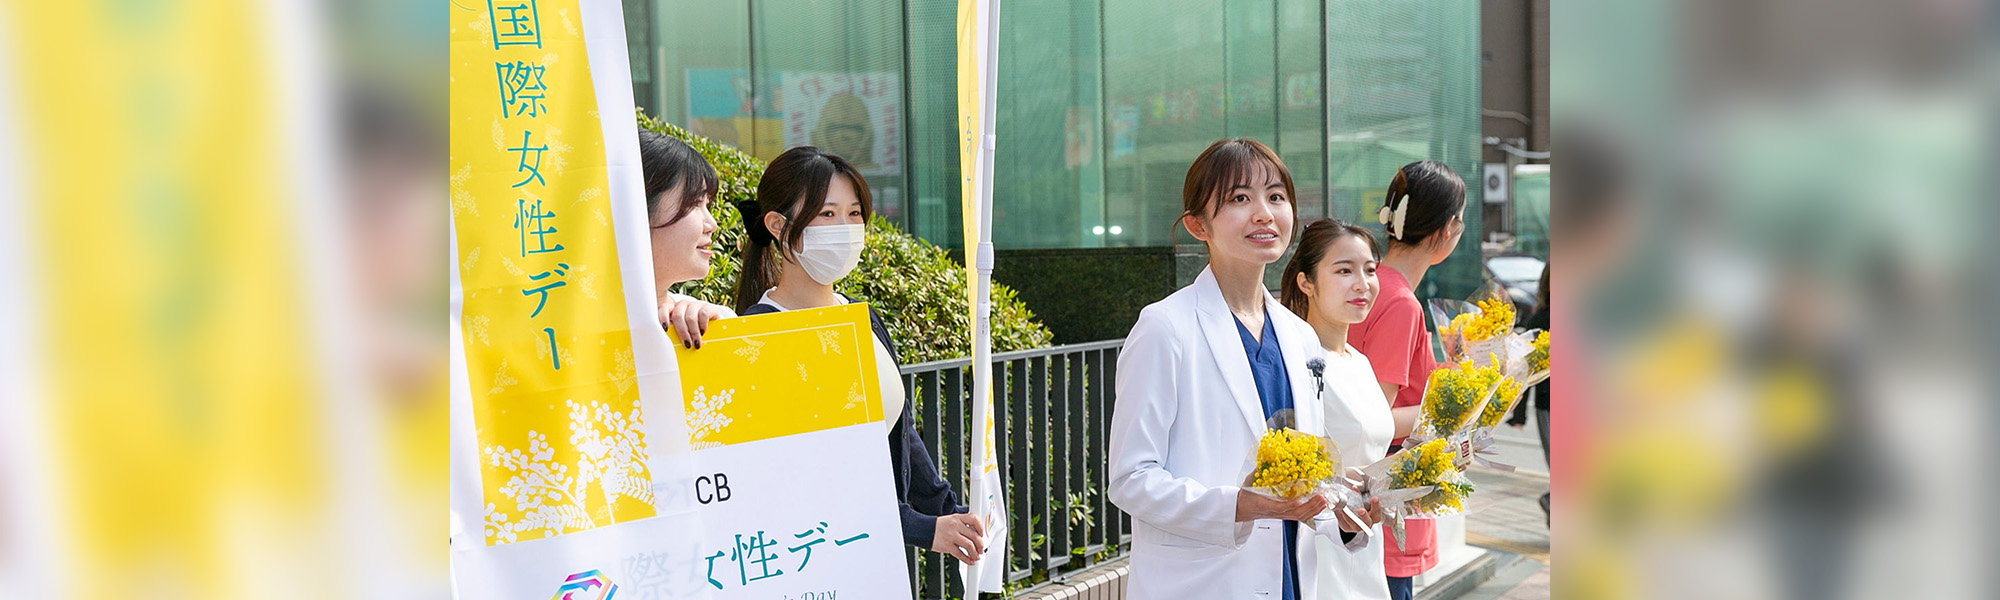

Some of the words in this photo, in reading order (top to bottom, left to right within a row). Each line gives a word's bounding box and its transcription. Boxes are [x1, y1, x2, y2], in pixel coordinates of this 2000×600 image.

[486, 0, 571, 371] 国際女性デー
